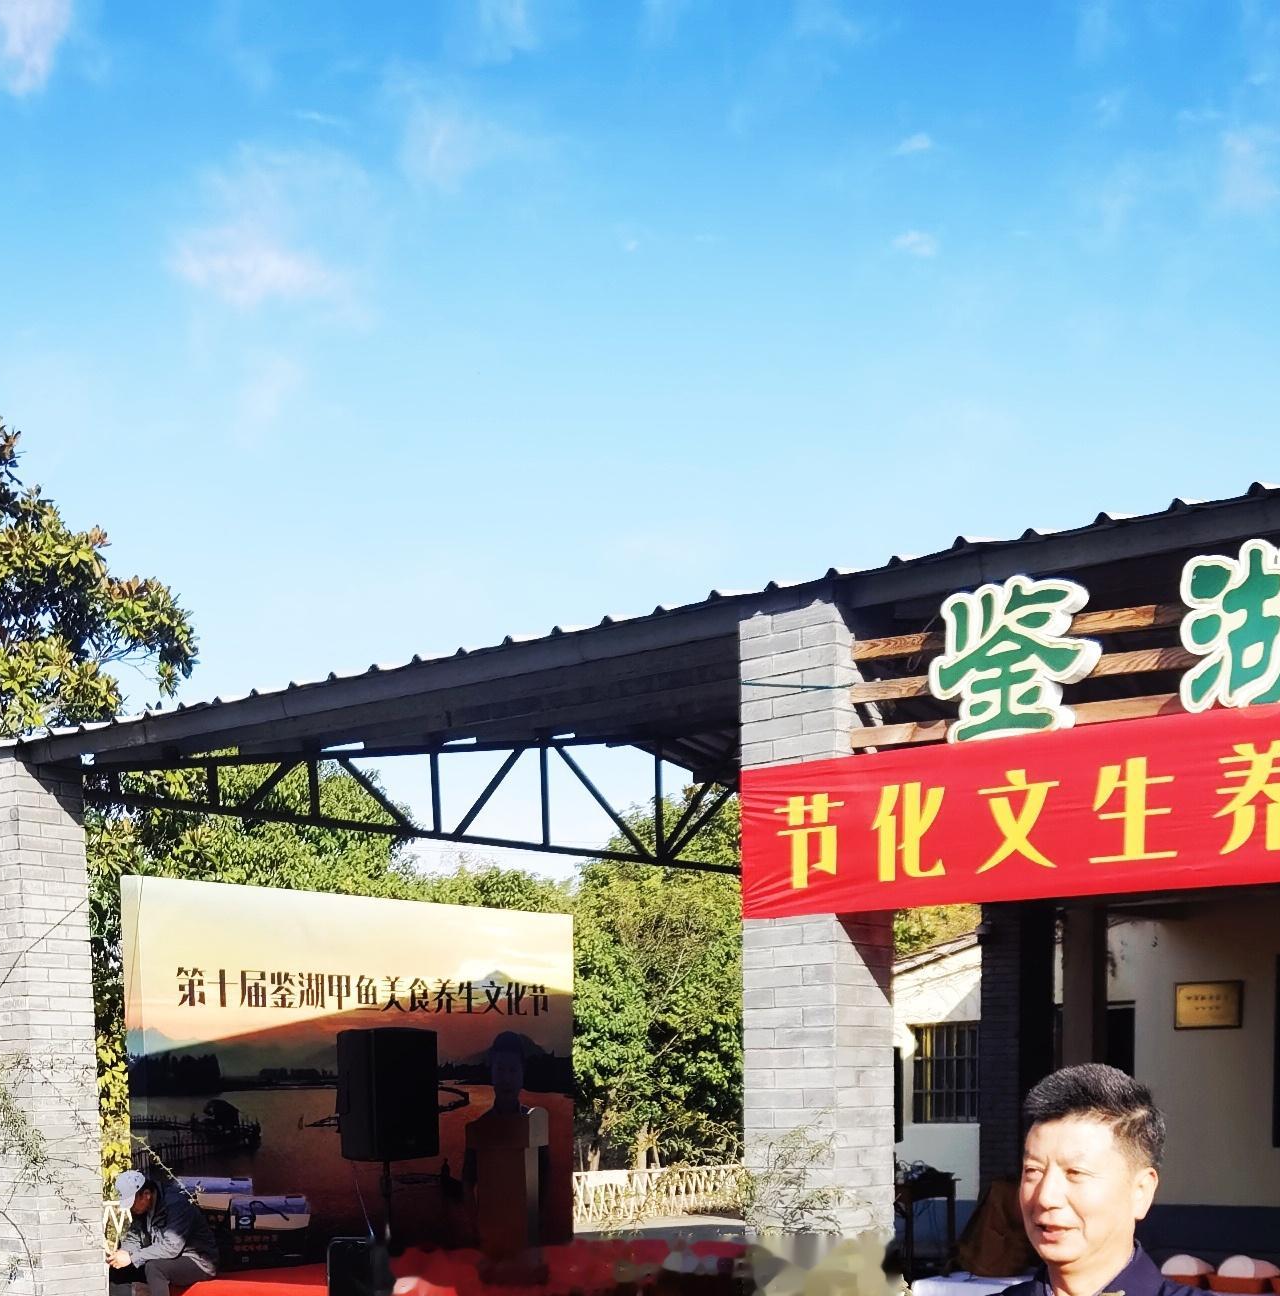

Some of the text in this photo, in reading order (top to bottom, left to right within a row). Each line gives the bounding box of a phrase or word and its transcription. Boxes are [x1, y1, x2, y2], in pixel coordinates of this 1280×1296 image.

[176, 966, 549, 1016] 第十届鉴湖甲鱼美食养生文化节
